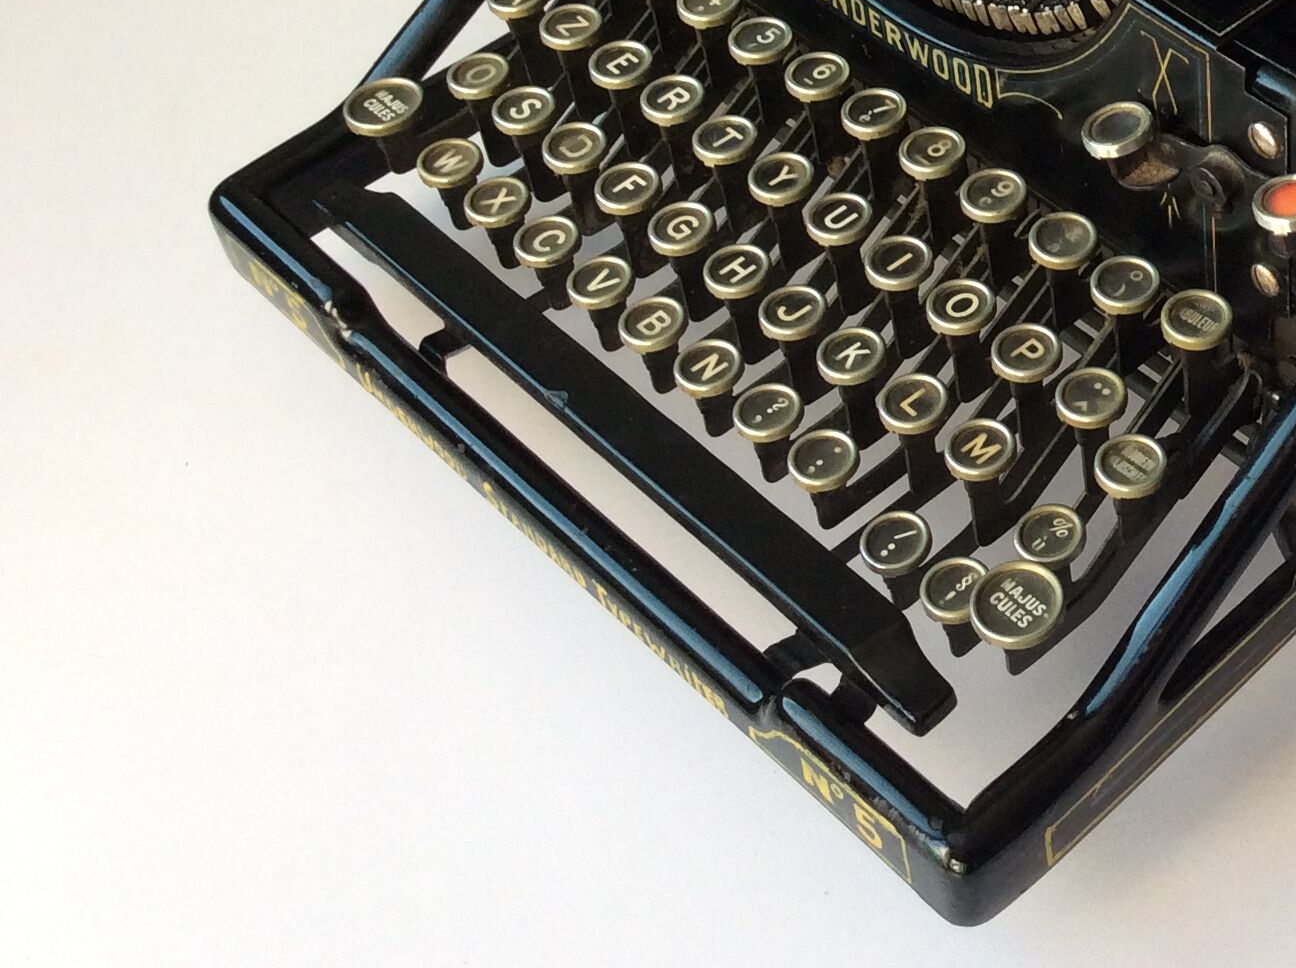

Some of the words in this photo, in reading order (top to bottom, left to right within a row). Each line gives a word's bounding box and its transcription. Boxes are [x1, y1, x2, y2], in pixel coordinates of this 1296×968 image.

[555, 15, 590, 36] Z
[756, 28, 781, 43] 5
[606, 52, 640, 75] E
[812, 63, 837, 79] 6
[509, 98, 542, 119] S
[657, 87, 690, 111] R
[873, 100, 897, 113] 7
[712, 126, 744, 149] T
[927, 139, 951, 157] 8
[433, 149, 469, 173] W
[612, 174, 647, 193] F
[768, 165, 798, 187] Y
[481, 187, 516, 213] X
[991, 180, 1015, 197] 9
[667, 215, 699, 240] G
[824, 205, 859, 229] U
[533, 229, 566, 252] C
[719, 255, 757, 283] H
[887, 252, 913, 272] I
[586, 268, 621, 293] V
[777, 304, 812, 321] J
[945, 292, 979, 318] O
[637, 310, 671, 335] B
[835, 341, 871, 370] K
[1010, 338, 1045, 359] P
[690, 353, 728, 381] N
[900, 388, 926, 417] L
[961, 433, 1002, 464] M
[1049, 518, 1074, 538] %
[990, 592, 1033, 628] CULES
[853, 802, 883, 850] 5
